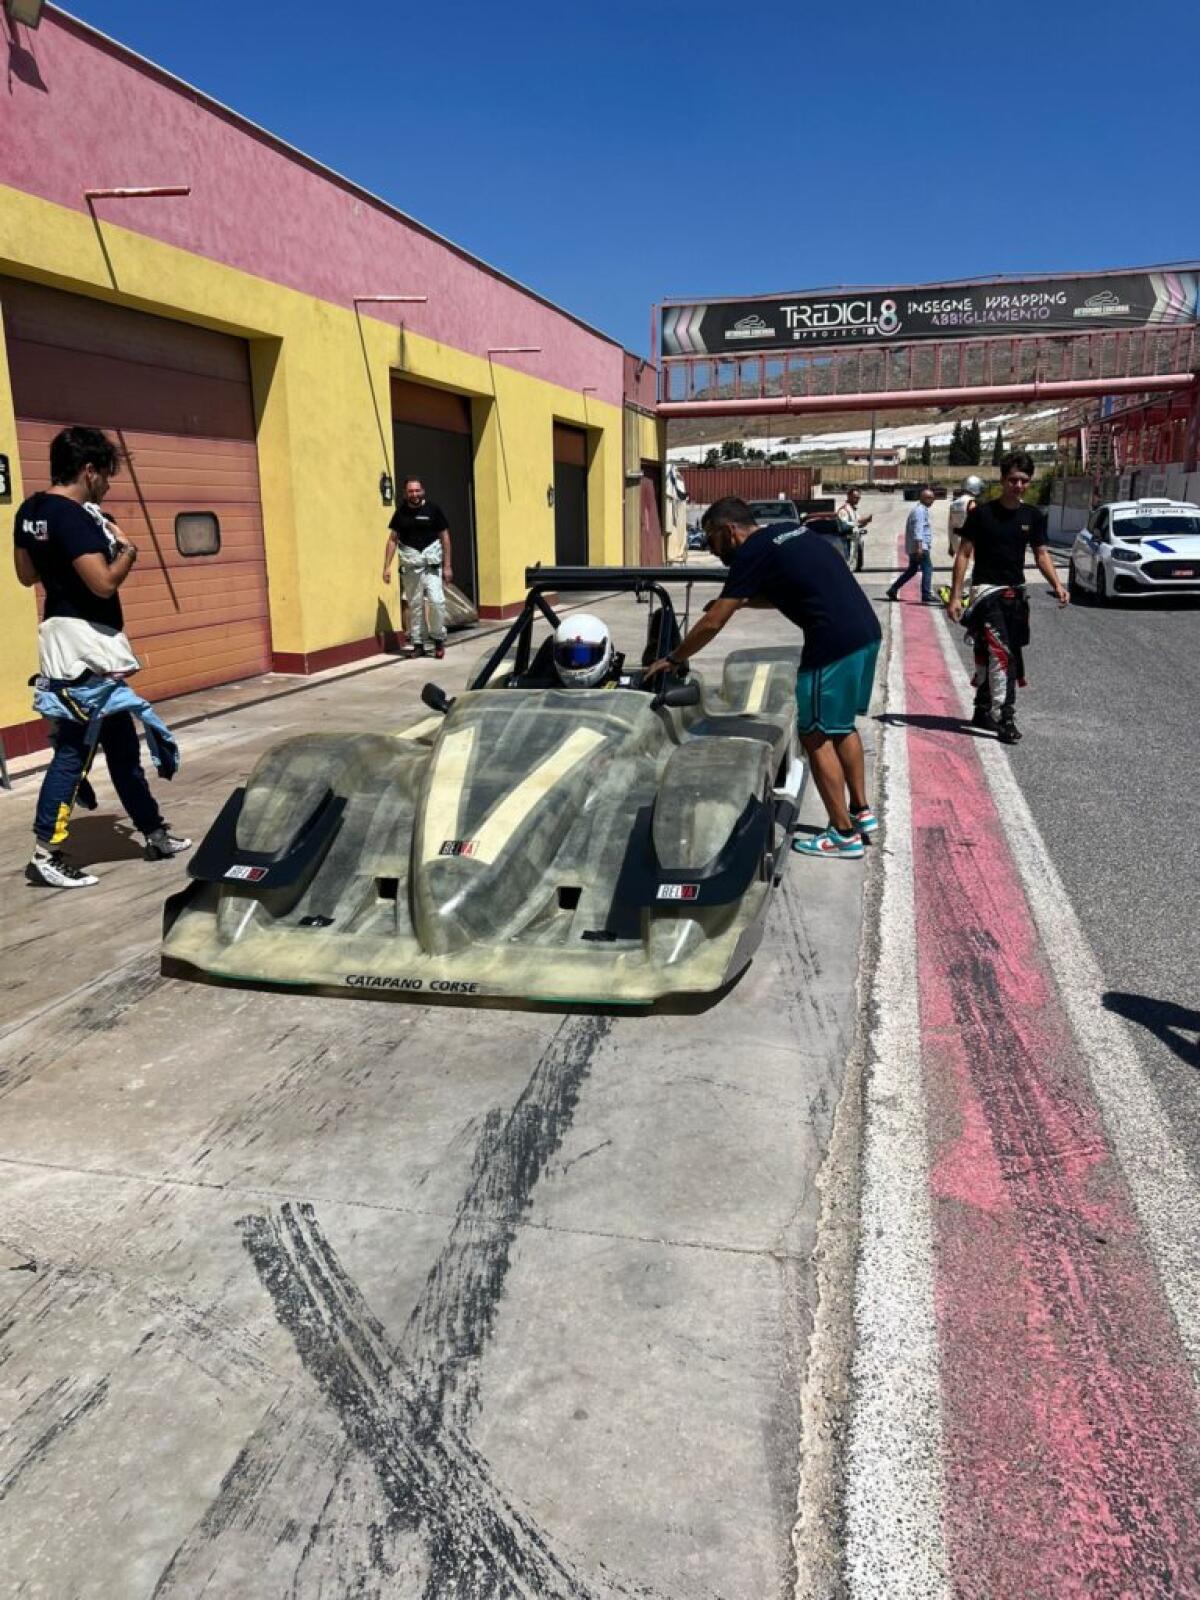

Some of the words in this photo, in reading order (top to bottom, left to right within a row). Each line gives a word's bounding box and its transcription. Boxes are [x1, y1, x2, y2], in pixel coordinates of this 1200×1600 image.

[907, 297, 973, 315] INSEGNE
[985, 291, 1067, 309] WRAPPING
[931, 306, 1050, 326] ABBIGLIAMENTO
[345, 974, 423, 990] CATAPANO
[429, 980, 480, 993] CORSE
